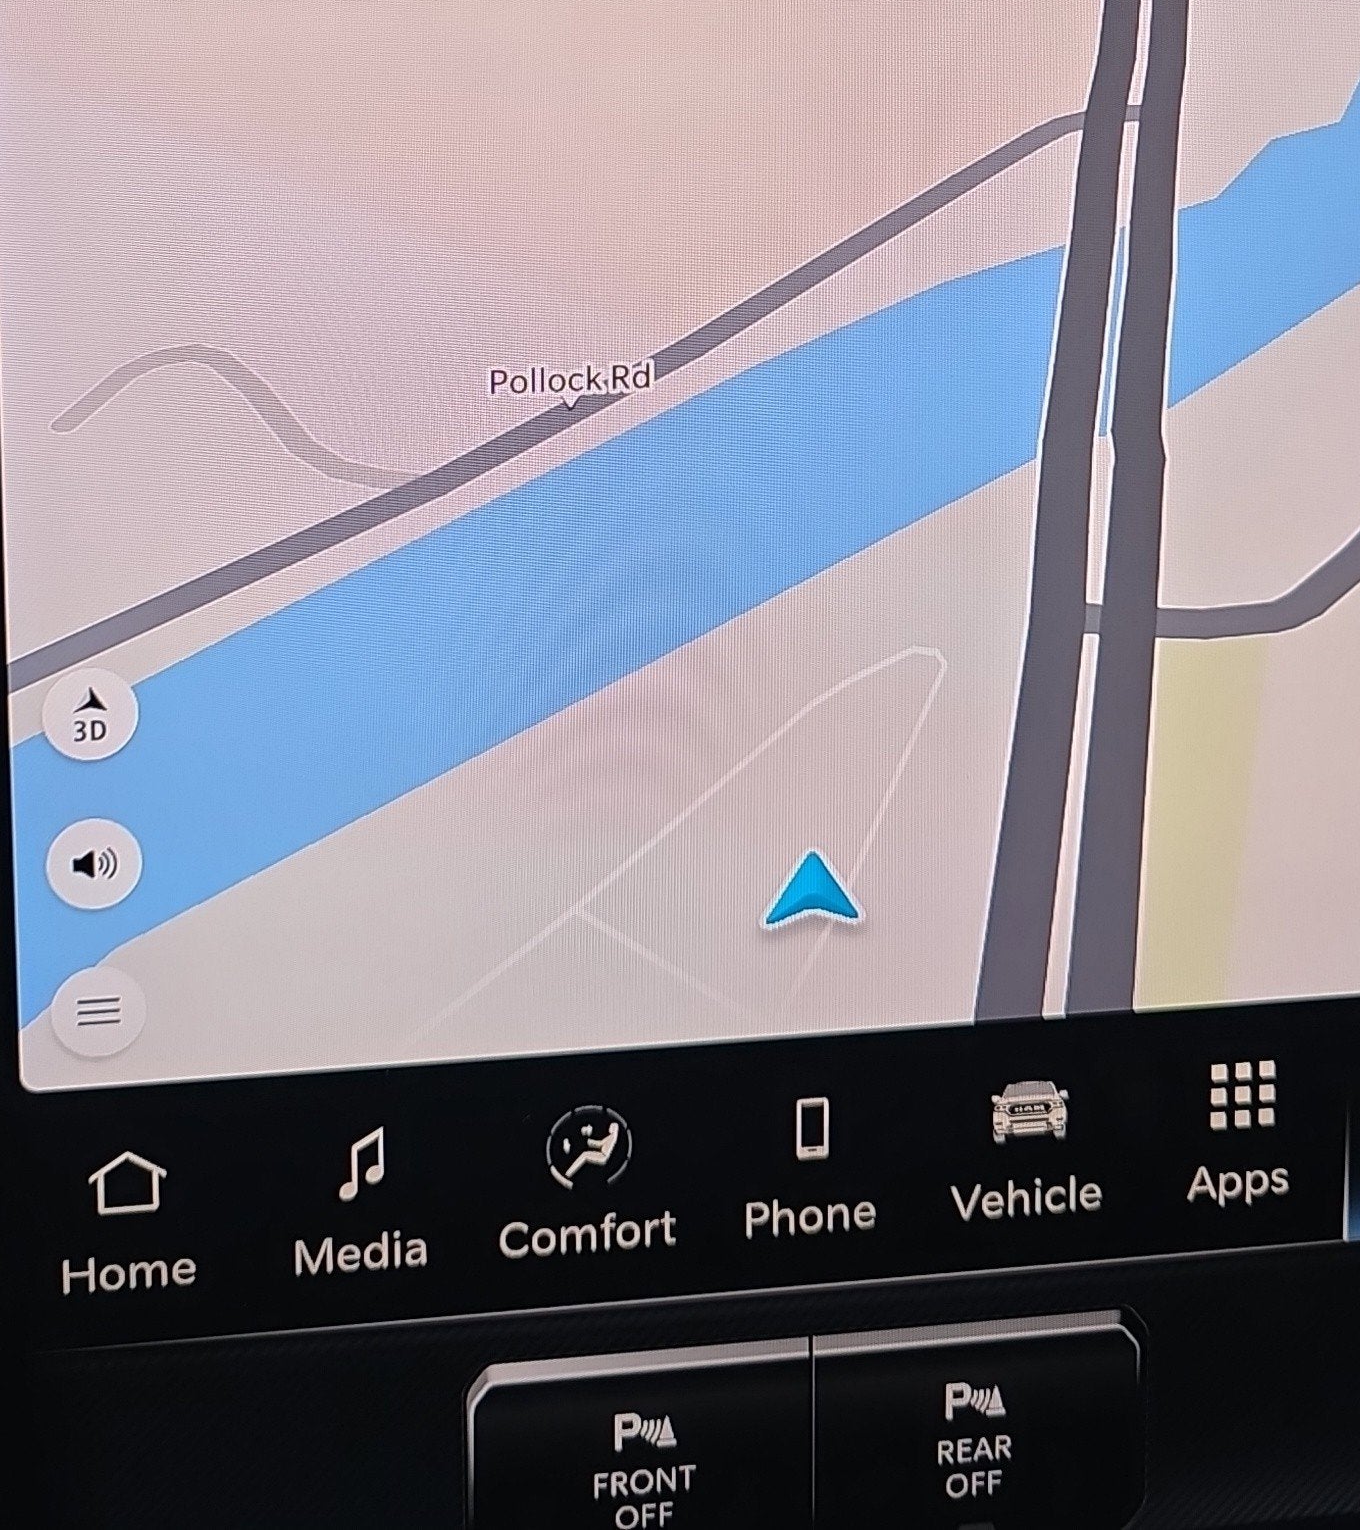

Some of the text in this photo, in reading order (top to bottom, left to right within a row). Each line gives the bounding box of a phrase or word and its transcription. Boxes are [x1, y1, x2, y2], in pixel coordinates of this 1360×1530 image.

[490, 364, 650, 395] Pollock Rd
[73, 719, 107, 743] 3D
[950, 1174, 1103, 1221] Vehicle
[1186, 1165, 1290, 1208] Apps
[499, 1210, 677, 1258] Comfort
[745, 1198, 877, 1240] Phone
[294, 1229, 428, 1276] Media
[62, 1256, 197, 1295] Home
[937, 1434, 1012, 1466] REAR
[593, 1464, 697, 1500] FRONT
[945, 1469, 1003, 1499] OFF
[615, 1501, 674, 1529] OFF
